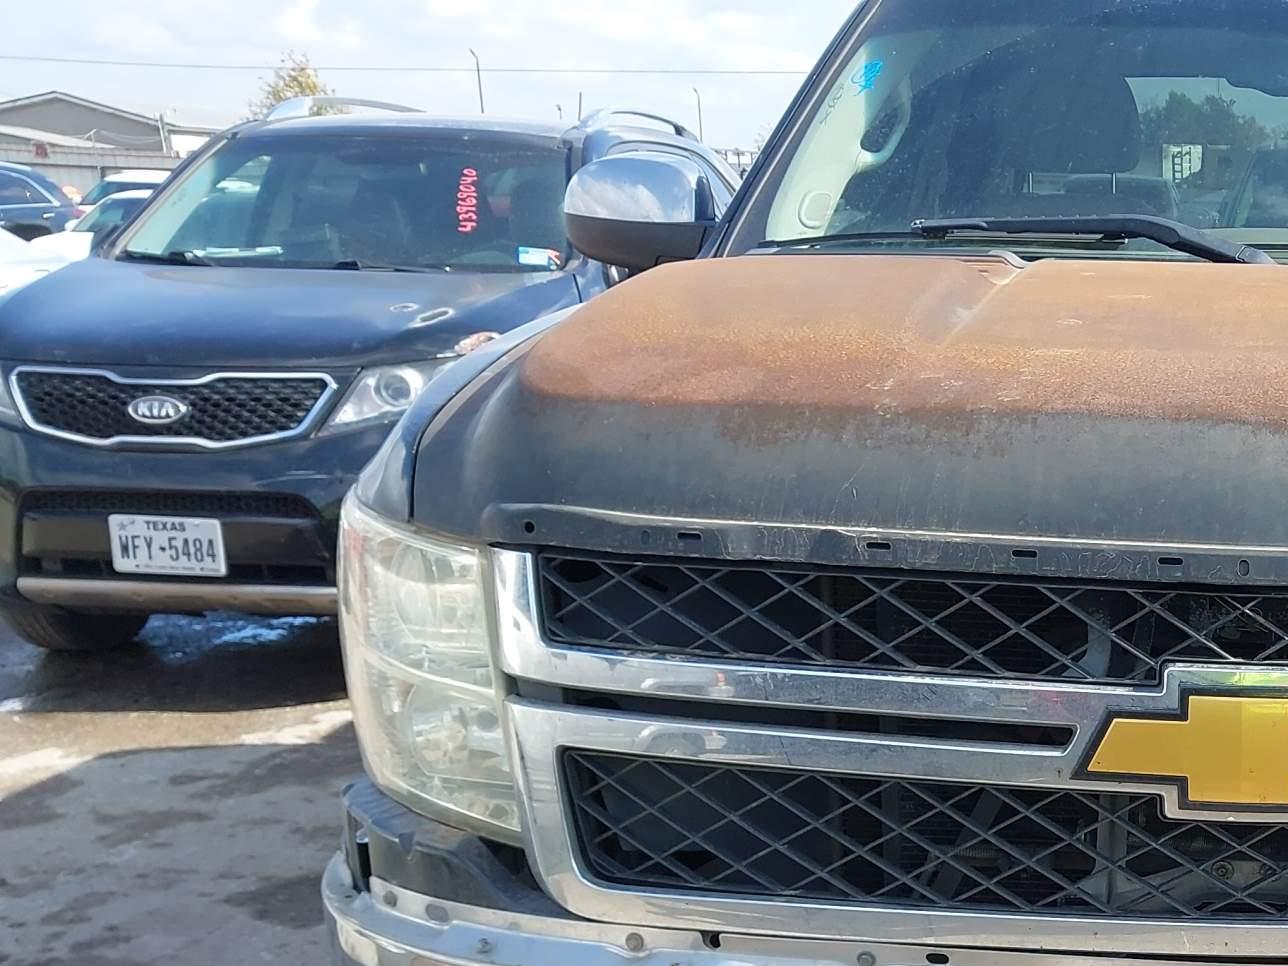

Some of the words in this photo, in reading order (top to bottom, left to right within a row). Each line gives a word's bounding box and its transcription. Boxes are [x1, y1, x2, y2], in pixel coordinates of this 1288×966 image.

[456, 168, 478, 232] 43969040
[138, 401, 175, 418] KIA
[144, 520, 187, 533] TEXAS
